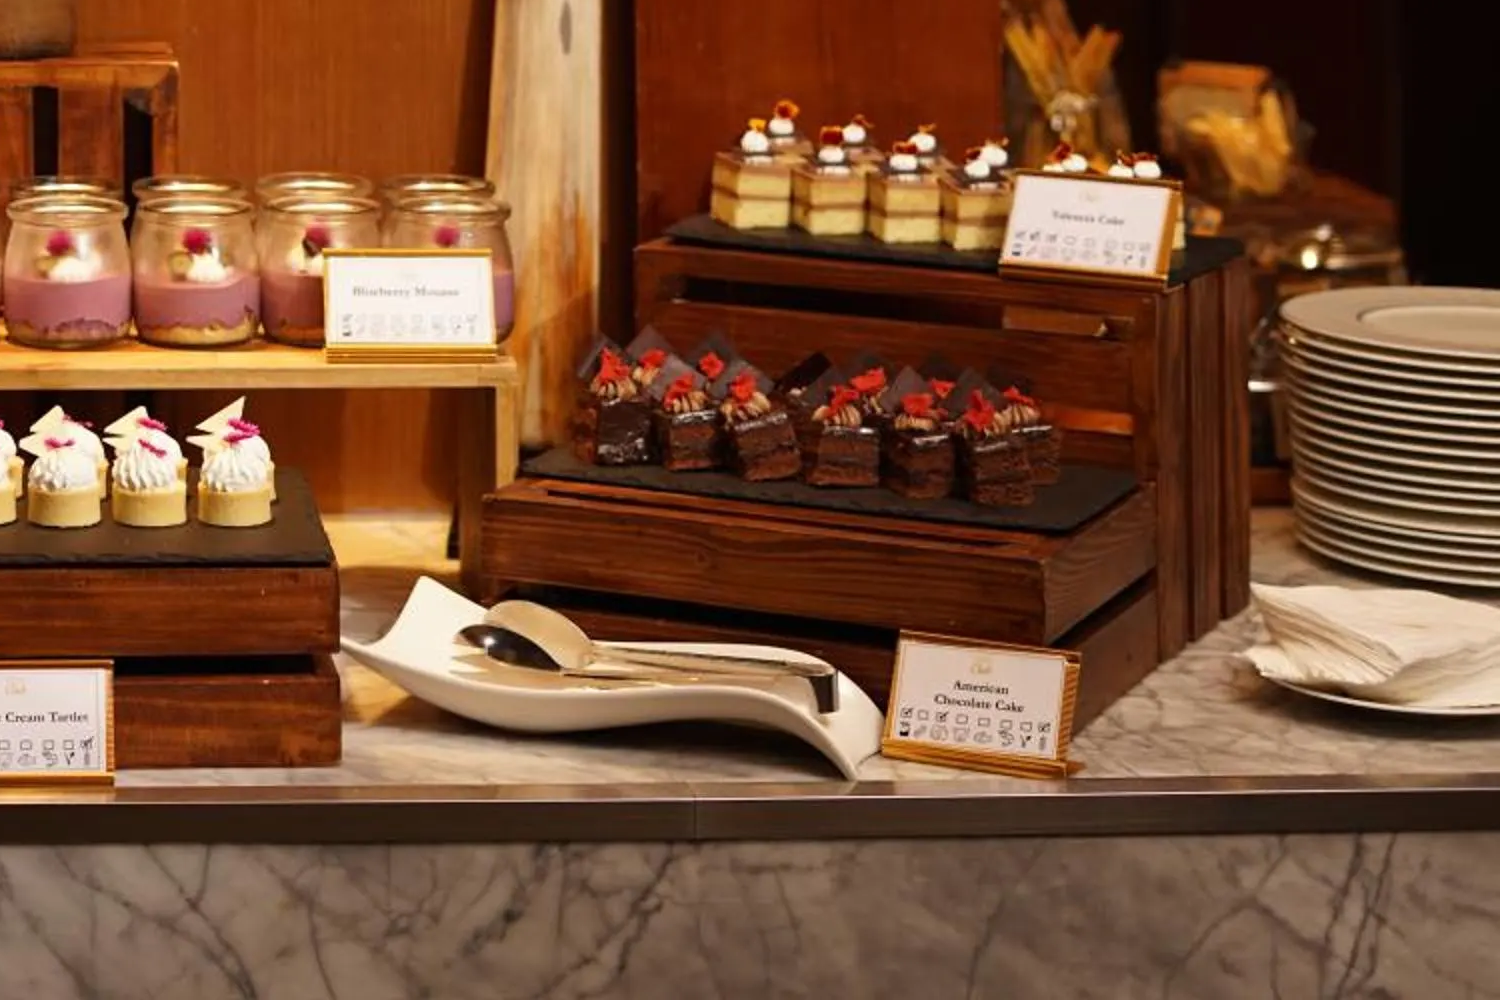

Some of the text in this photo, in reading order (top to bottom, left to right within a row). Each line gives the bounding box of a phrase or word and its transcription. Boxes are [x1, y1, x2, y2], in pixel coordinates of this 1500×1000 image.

[953, 679, 1009, 695] American
[933, 693, 1025, 713] Chocolate Cake
[5, 711, 45, 723] Cream
